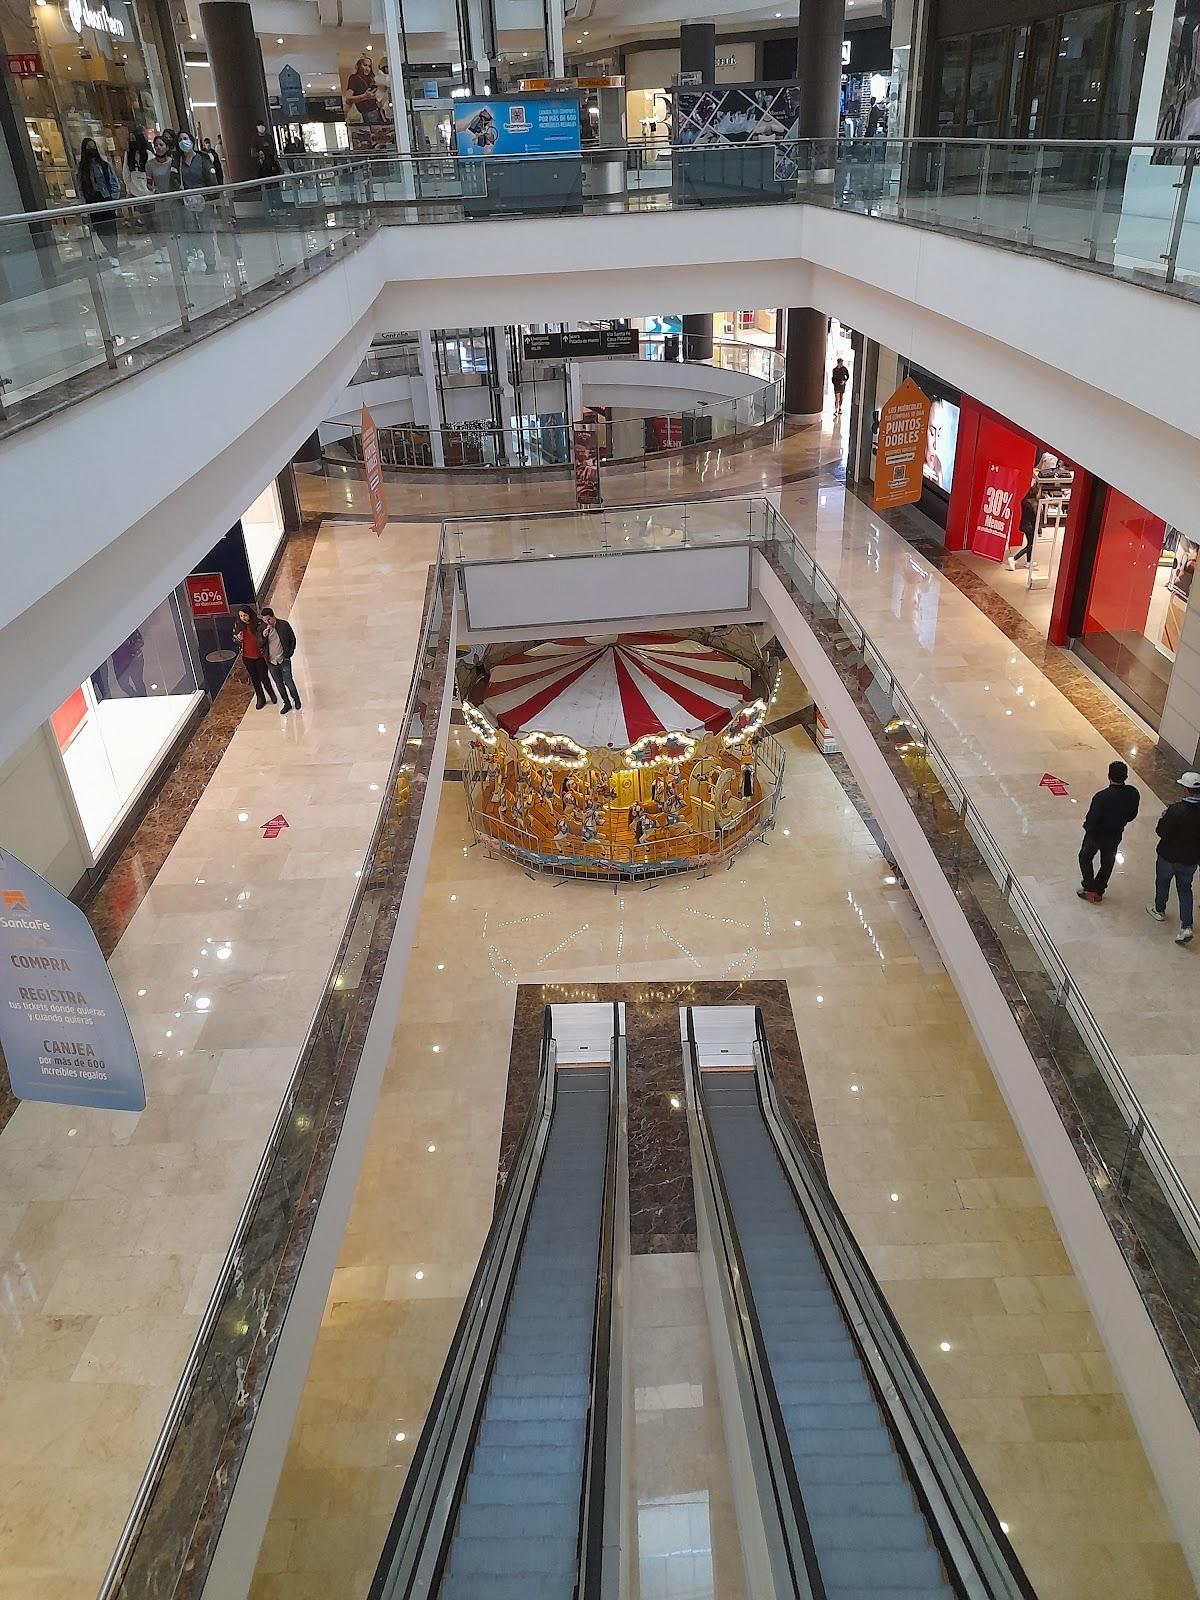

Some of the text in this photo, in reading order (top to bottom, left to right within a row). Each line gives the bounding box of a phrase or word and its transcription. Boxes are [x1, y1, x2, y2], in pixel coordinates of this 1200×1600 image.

[885, 418, 922, 435] PUNTOS
[884, 430, 920, 448] DOBLES
[983, 486, 1013, 520] 30%
[984, 514, 1006, 532] Menos
[193, 591, 222, 602] 50%
[0, 917, 51, 931] SantaFe
[11, 955, 71, 971] COMPRA
[19, 987, 87, 1005] REGISTRA
[9, 1001, 106, 1017] tus tickets donde quieras
[28, 1013, 94, 1025] y cuando quieras
[44, 1040, 95, 1057] CANJEA
[39, 1057, 105, 1069] por más de 600
[80, 1070, 108, 1081] regalos
